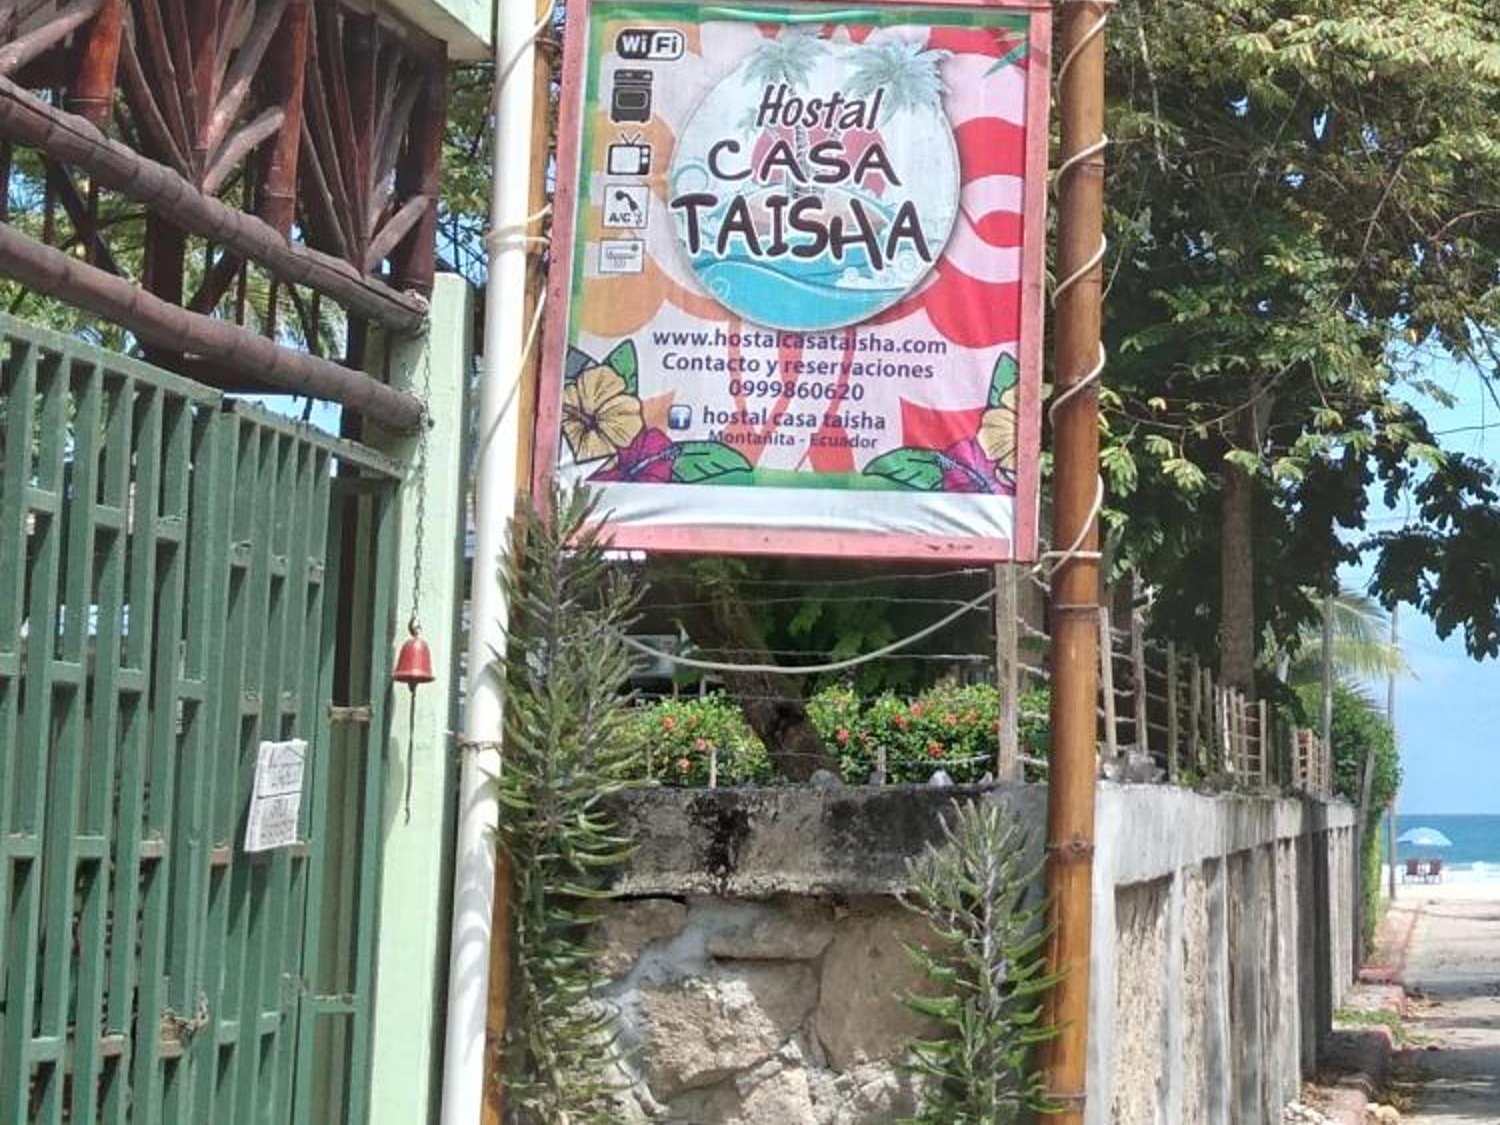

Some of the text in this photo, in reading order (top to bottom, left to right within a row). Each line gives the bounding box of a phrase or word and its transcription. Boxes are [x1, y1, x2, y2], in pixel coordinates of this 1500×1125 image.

[757, 83, 885, 130] Hostal
[707, 139, 902, 187] CASA
[608, 211, 632, 224] A/C
[671, 192, 933, 271] TAISHA
[652, 328, 947, 355] www.hostalcasataisha.com
[662, 352, 934, 379] Contacto y reservaciones
[729, 379, 865, 402] 0999860620
[703, 406, 886, 431] hostal casa taisha
[809, 433, 878, 449] Ecuador
